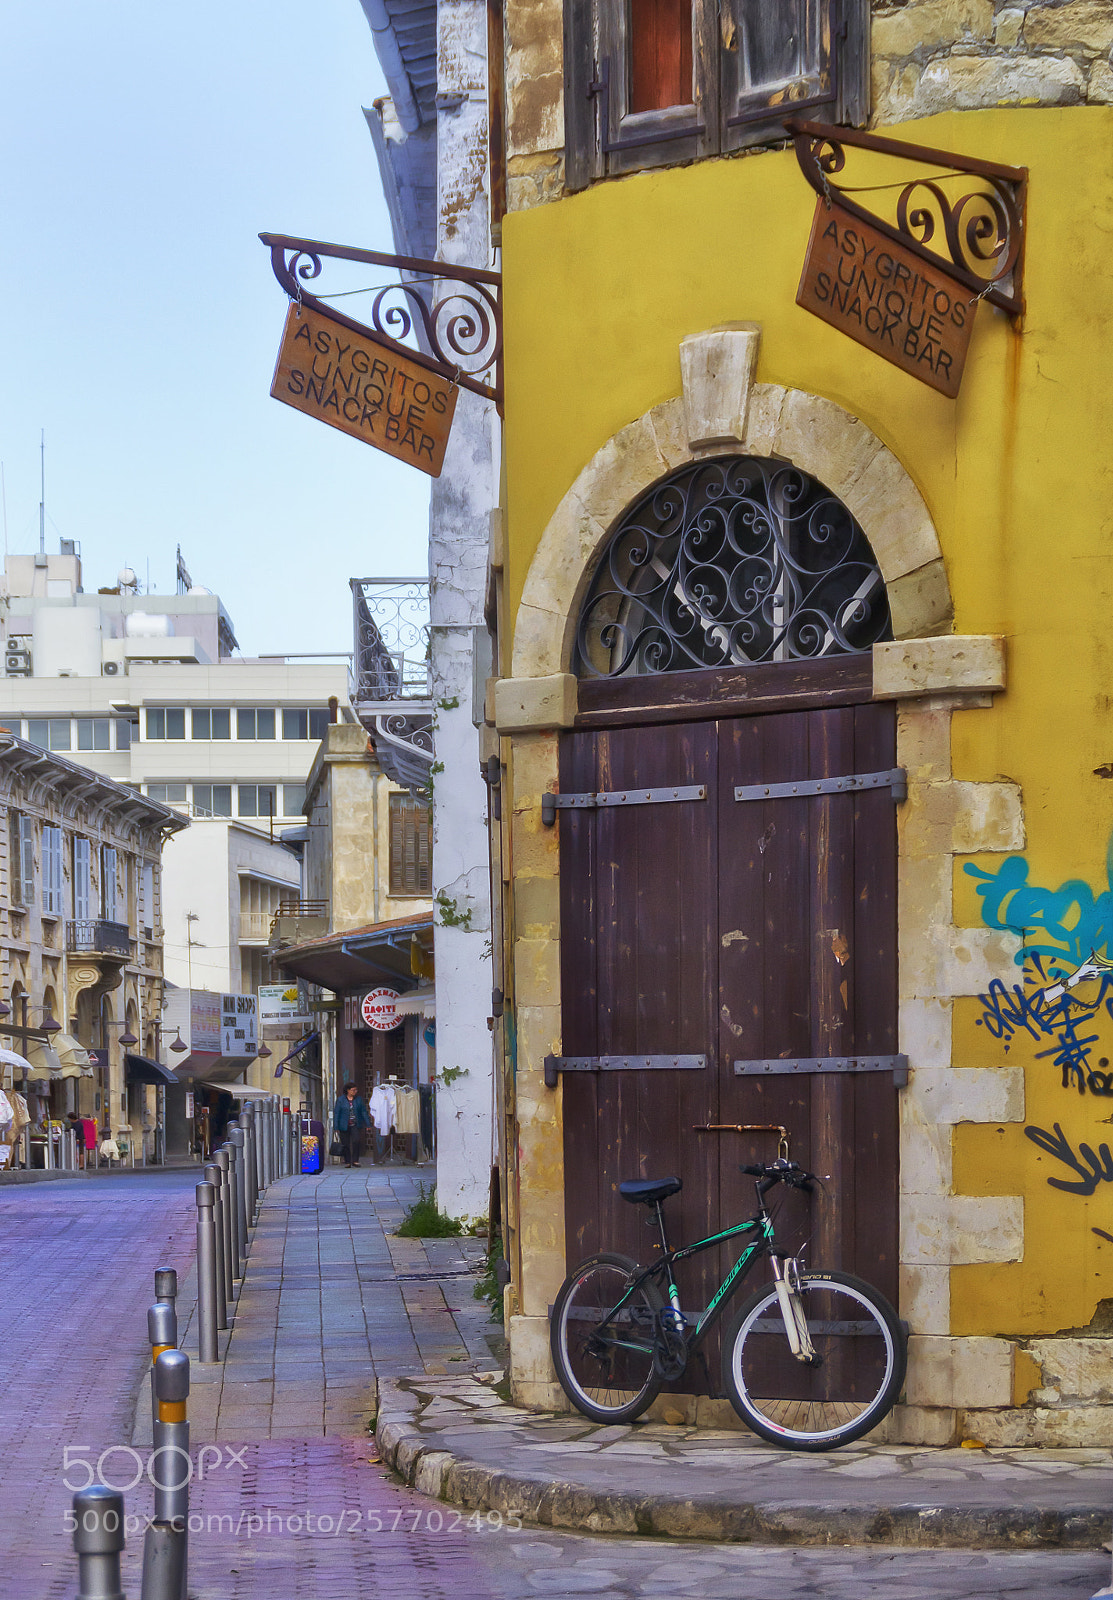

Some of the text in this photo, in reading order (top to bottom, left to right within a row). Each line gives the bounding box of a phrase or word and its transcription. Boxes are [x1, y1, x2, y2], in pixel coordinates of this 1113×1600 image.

[822, 219, 967, 329] ASYGRITOS
[838, 256, 945, 346] UNIQUE
[294, 322, 448, 414] ASYGRITOS
[814, 271, 953, 381] SNACK BAR
[287, 369, 436, 462] SNACK BAR
[312, 354, 426, 431] UNIQUE
[363, 1004, 396, 1014] ΠΑΦΙΤΙ
[365, 1014, 403, 1030] ΚΑΤΑΣΤΗΜ
